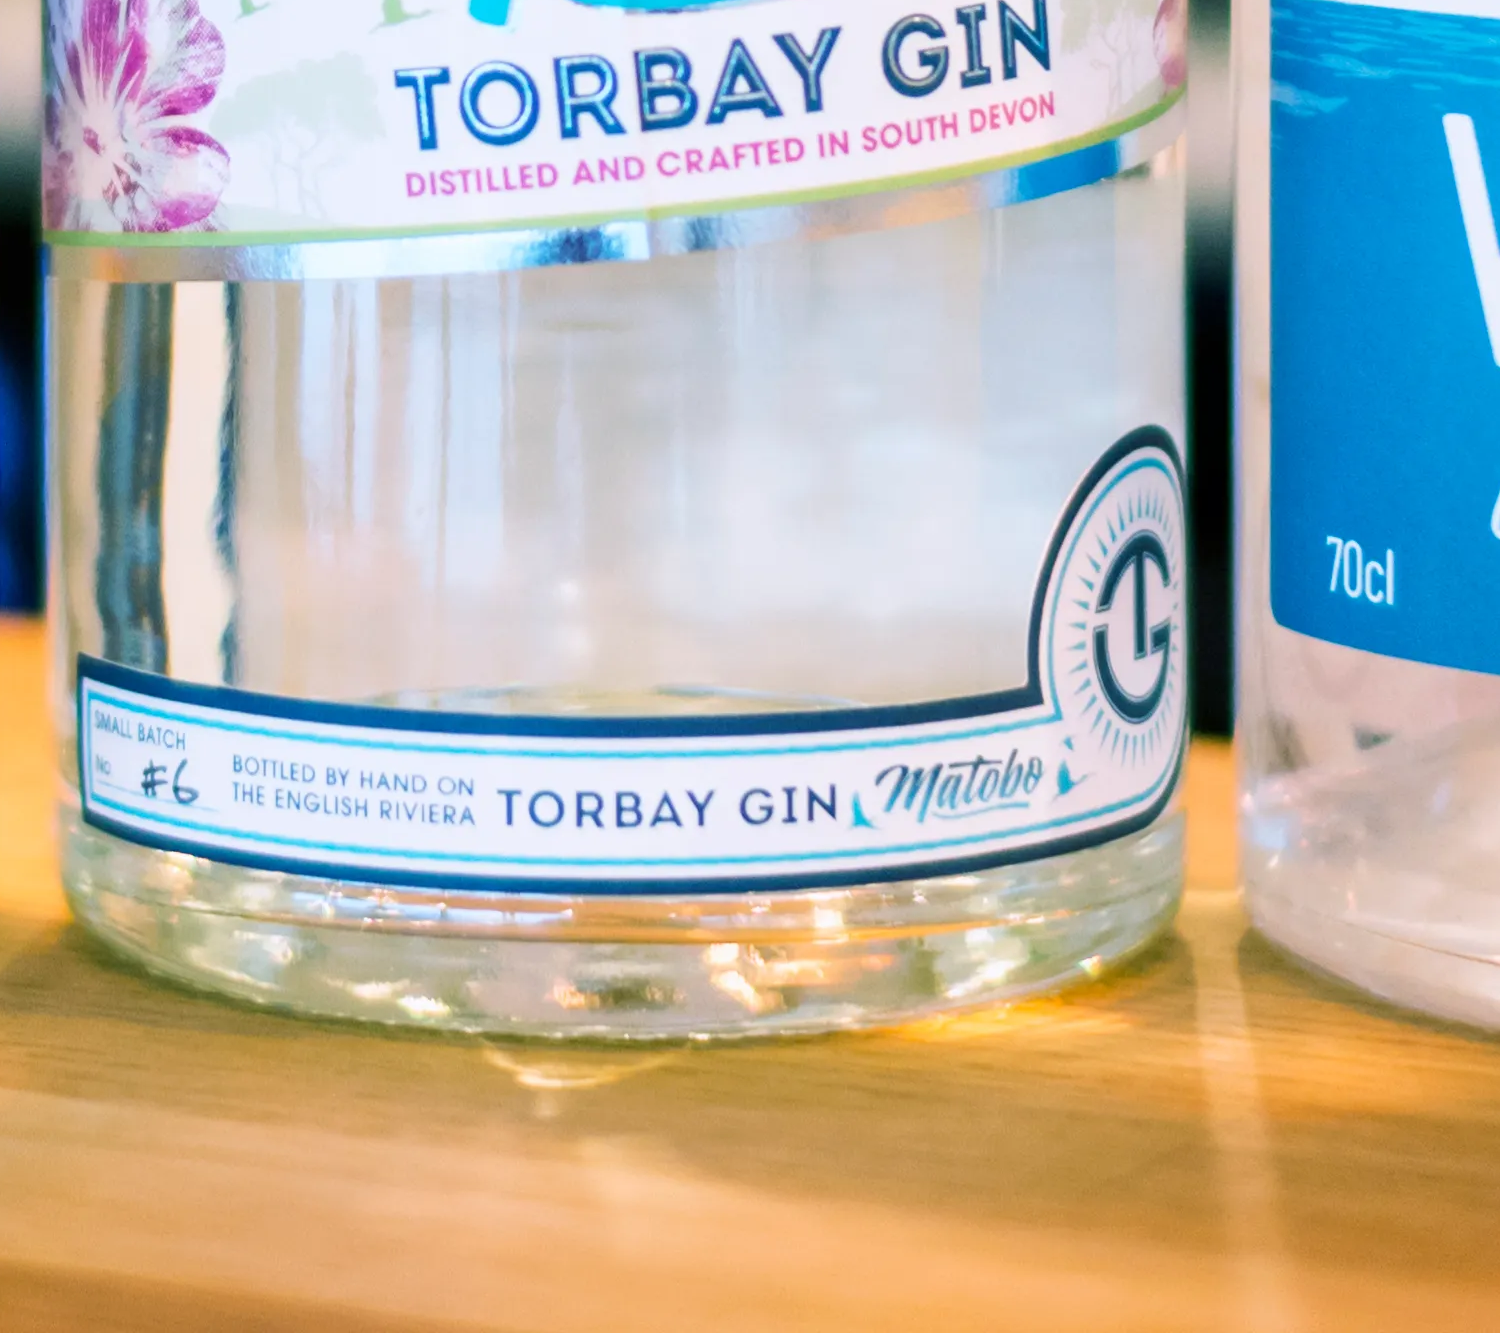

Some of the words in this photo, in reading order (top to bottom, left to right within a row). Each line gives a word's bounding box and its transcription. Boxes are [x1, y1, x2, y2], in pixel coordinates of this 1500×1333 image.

[395, 27, 842, 151] TORBAY
[406, 163, 559, 198] DISTILLED
[573, 156, 645, 186] AND
[657, 136, 805, 178] CRAFTED
[818, 130, 850, 159] IN
[862, 111, 960, 153] SOUTH
[969, 92, 1056, 132] DEVON
[1326, 536, 1395, 605] 70cl
[94, 710, 132, 740] SMALL
[137, 726, 186, 751] BATCH
[140, 759, 200, 805] #6
[232, 754, 316, 783] BOTTLED
[325, 766, 350, 787] BY
[360, 770, 427, 794] HAND
[437, 776, 475, 796] ON
[875, 748, 1043, 824] Matobo
[232, 782, 265, 806] THE
[275, 788, 370, 818] ENGLISH
[380, 799, 476, 826] RIVIERA
[498, 788, 716, 828] TORBAY
[739, 784, 837, 826] GIN
